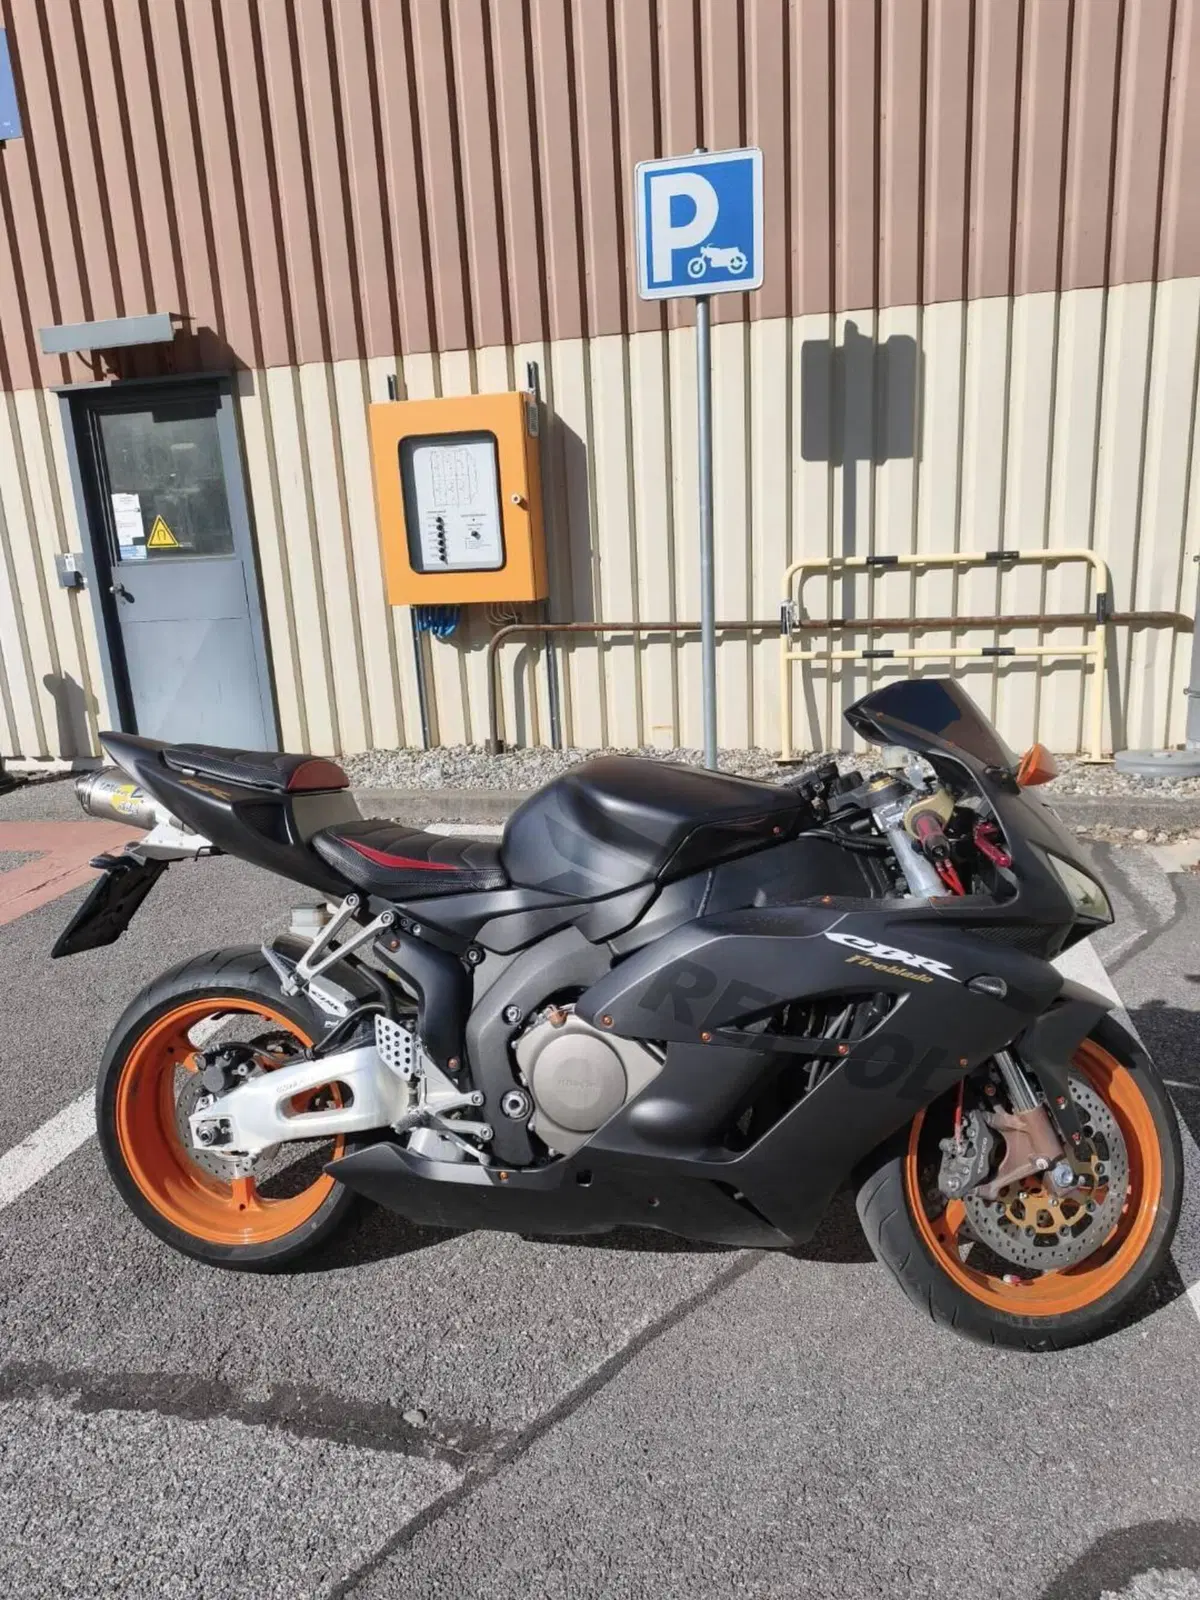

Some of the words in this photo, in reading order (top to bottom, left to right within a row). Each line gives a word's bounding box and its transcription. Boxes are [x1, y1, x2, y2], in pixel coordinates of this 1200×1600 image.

[650, 172, 720, 283] P
[823, 932, 963, 983] CBR
[639, 958, 949, 1104] REOL
